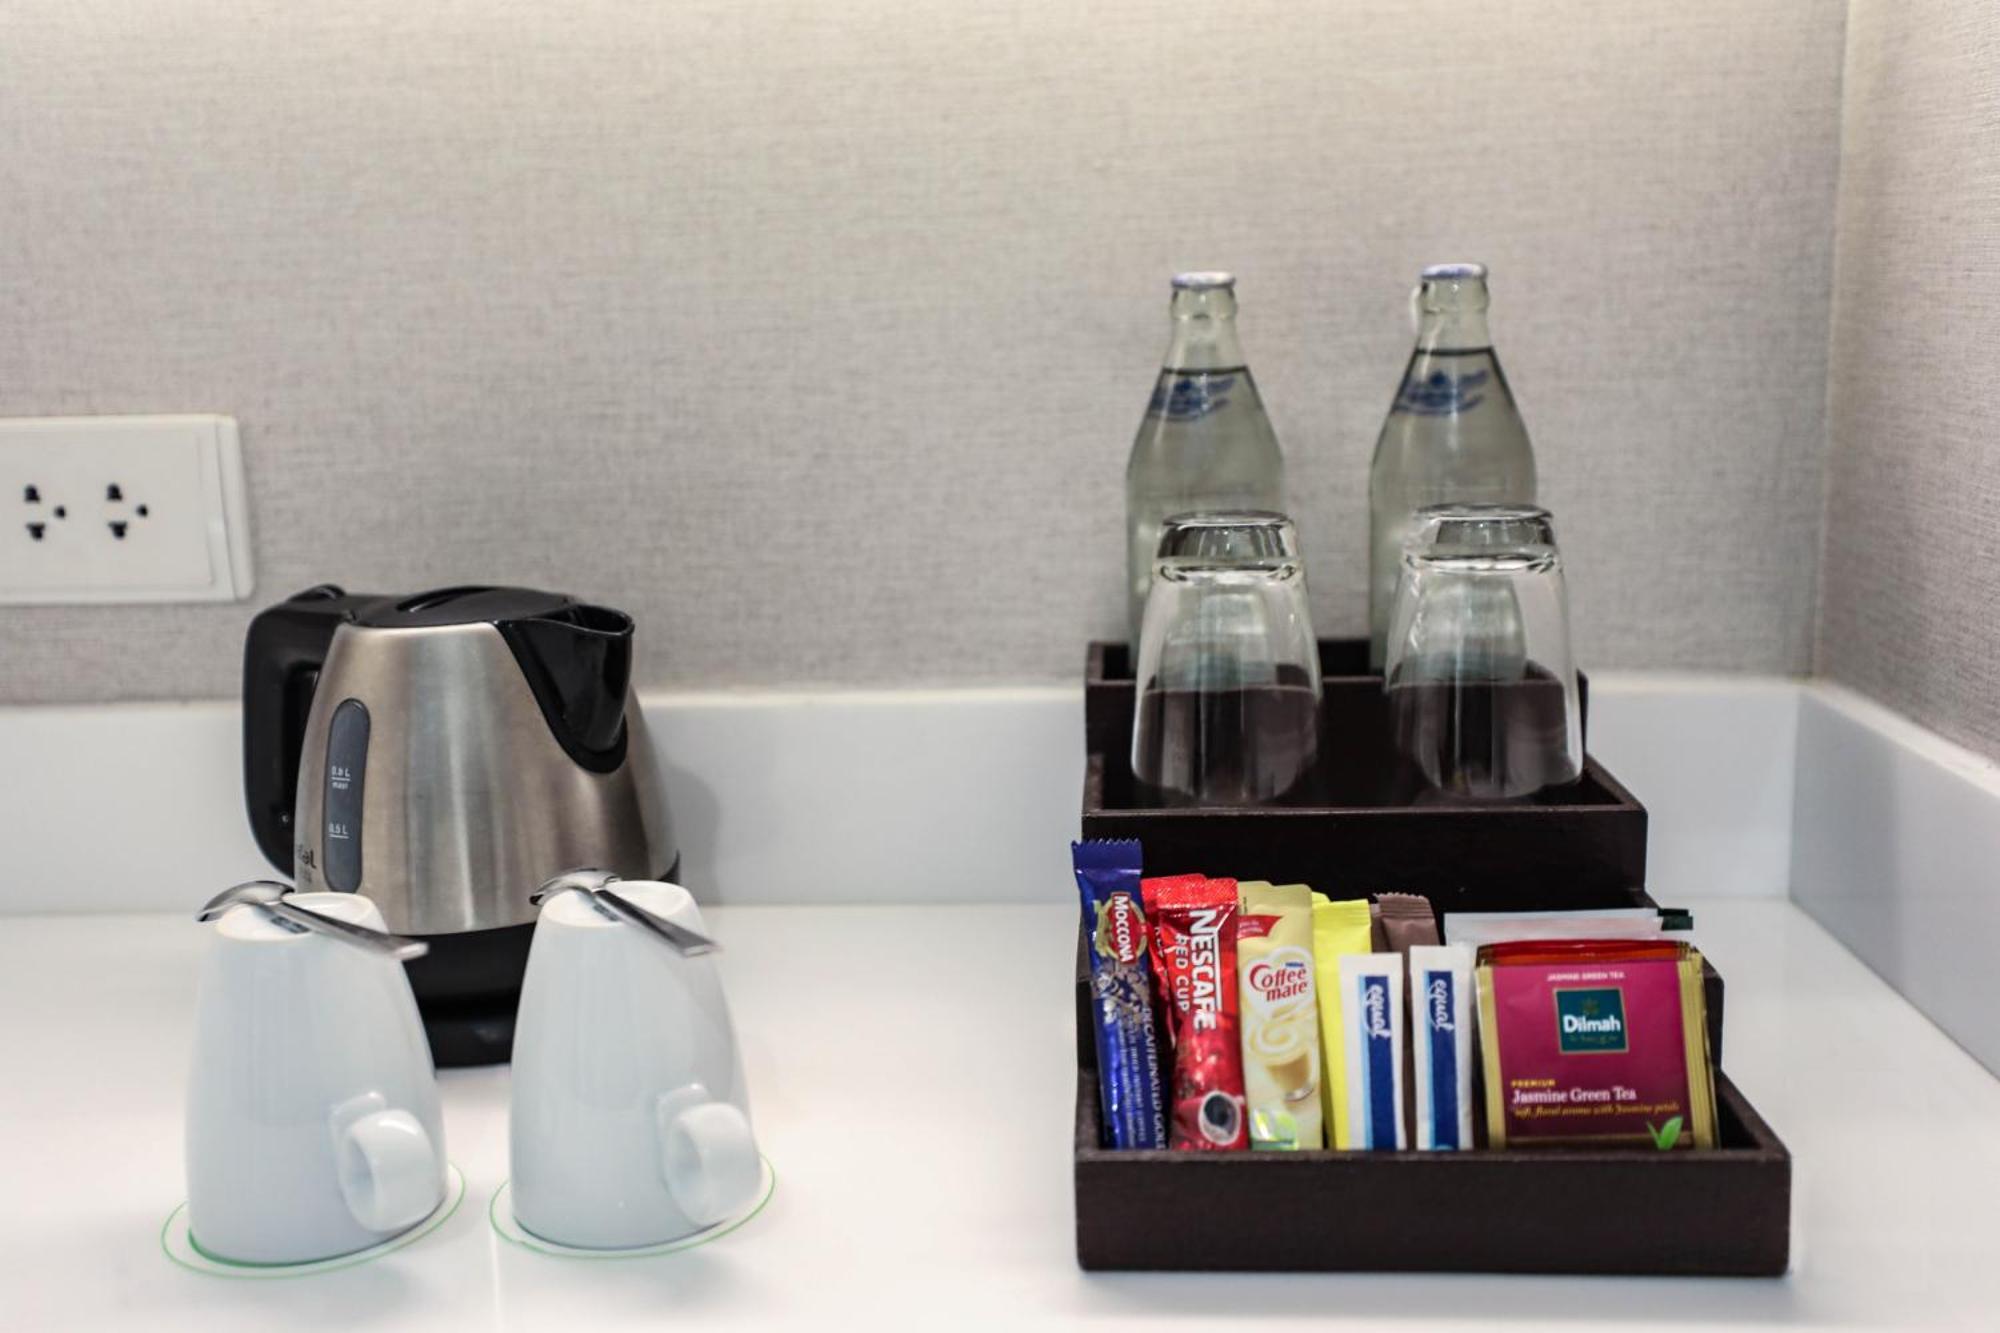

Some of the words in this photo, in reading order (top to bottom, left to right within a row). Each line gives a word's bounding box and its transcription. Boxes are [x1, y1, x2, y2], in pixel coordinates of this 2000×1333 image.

[1113, 895, 1135, 963] MOCCONA
[1175, 933, 1189, 969] RED
[1249, 963, 1307, 992] Coffee
[1266, 981, 1308, 1002] mate
[1176, 975, 1190, 1013] CUP
[1429, 979, 1455, 1032] equal
[1365, 983, 1391, 1039] equal
[1563, 1014, 1621, 1033] Dilmah
[1511, 1079, 1556, 1088] PREMIUM
[1512, 1089, 1567, 1104] Jasmine
[1570, 1087, 1610, 1102] Green
[1611, 1085, 1637, 1100] Tea
